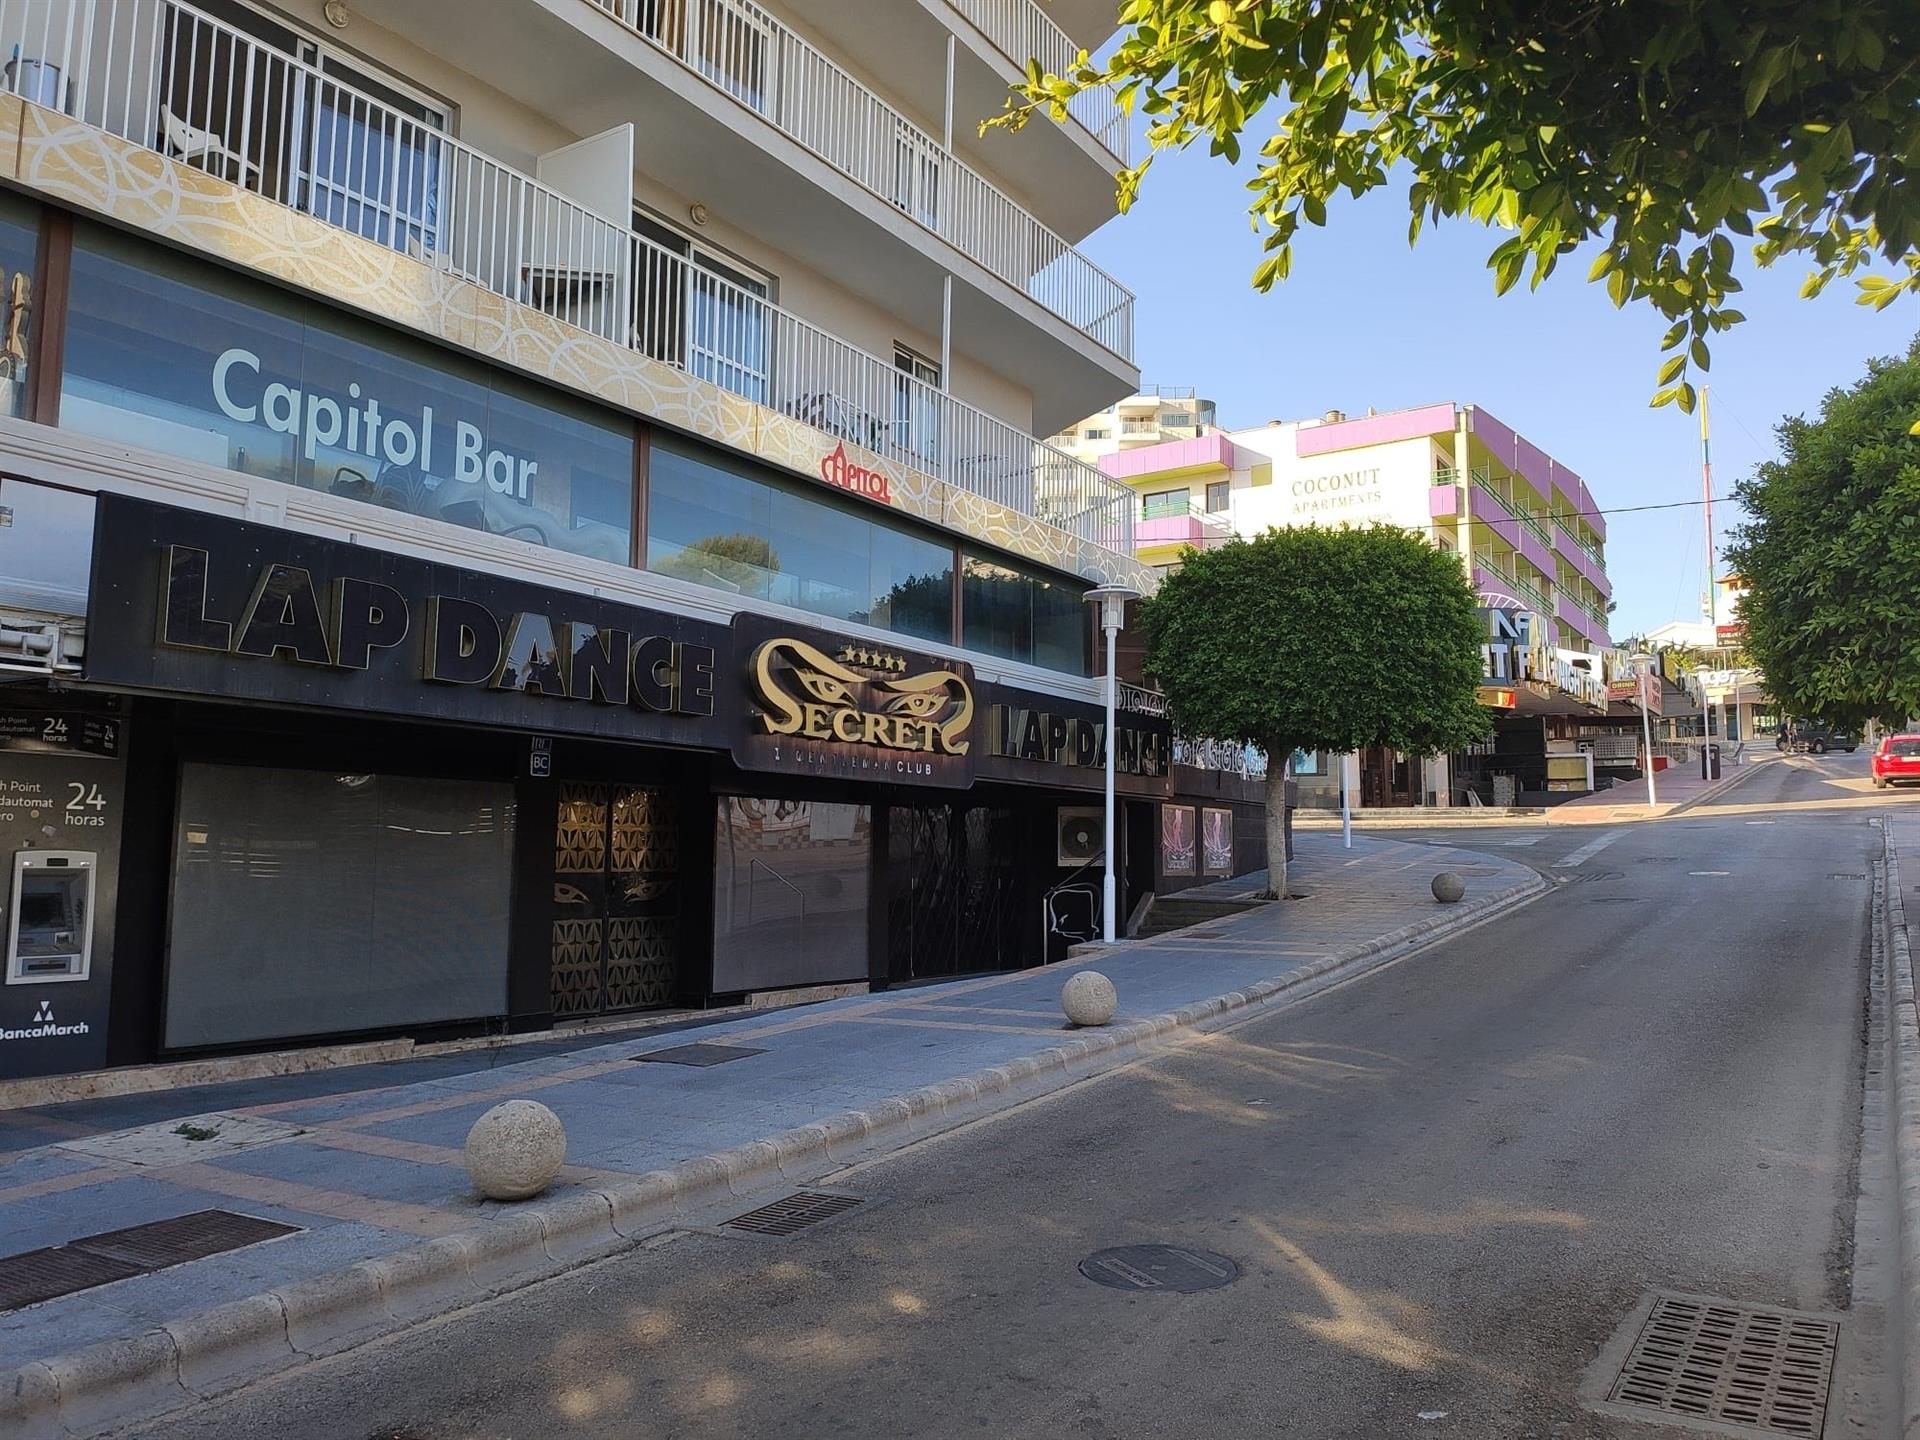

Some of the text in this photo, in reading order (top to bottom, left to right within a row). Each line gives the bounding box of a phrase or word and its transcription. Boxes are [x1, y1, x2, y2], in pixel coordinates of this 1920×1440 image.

[212, 348, 538, 499] Capitol Bar
[1291, 467, 1380, 497] COCONUT
[1292, 490, 1382, 513] APARTMENTS
[157, 544, 715, 717] LAP DANCE
[43, 717, 69, 734] 24
[42, 734, 68, 742] horas
[991, 703, 1170, 778] LAP DANCE
[533, 756, 548, 769] BC
[896, 759, 932, 776] CLUB
[10, 780, 42, 793] Point
[66, 782, 107, 811] 24
[64, 811, 105, 827] horas
[0, 1022, 89, 1040] BancaMarch
